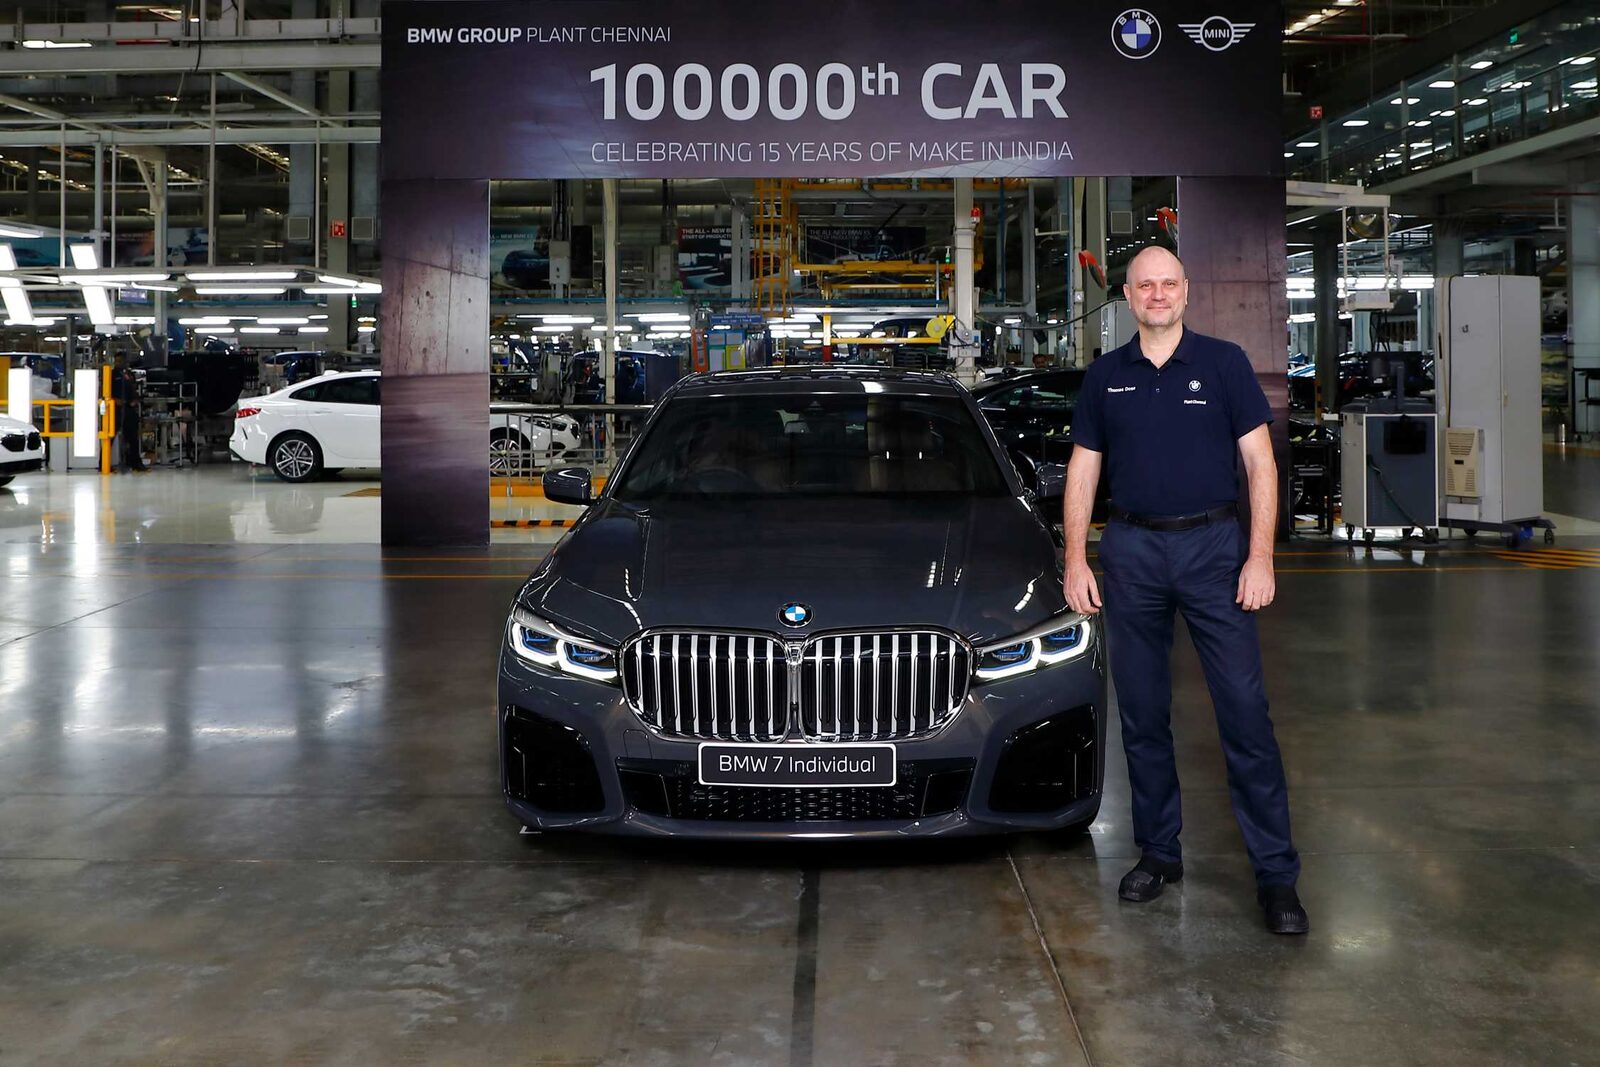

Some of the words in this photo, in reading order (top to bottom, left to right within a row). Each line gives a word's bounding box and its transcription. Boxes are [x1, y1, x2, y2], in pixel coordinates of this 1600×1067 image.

[1118, 11, 1155, 26] BMW
[407, 28, 453, 43] BMW
[458, 28, 522, 43] GROUP
[527, 27, 587, 42] PLANT
[591, 26, 671, 42] CHENNAI
[1204, 29, 1230, 39] MINI
[590, 62, 899, 121] 100000th
[920, 62, 1069, 120] CAR
[591, 142, 752, 163] CELEBRATING
[759, 142, 780, 162] 15
[786, 142, 863, 162] YEARS
[869, 142, 902, 162] OF
[909, 142, 974, 161] MAKE
[981, 142, 1003, 161] IN
[1011, 141, 1074, 161] INDIA
[719, 755, 768, 772] BMW
[772, 755, 784, 772] 7
[789, 755, 876, 772] Individual
